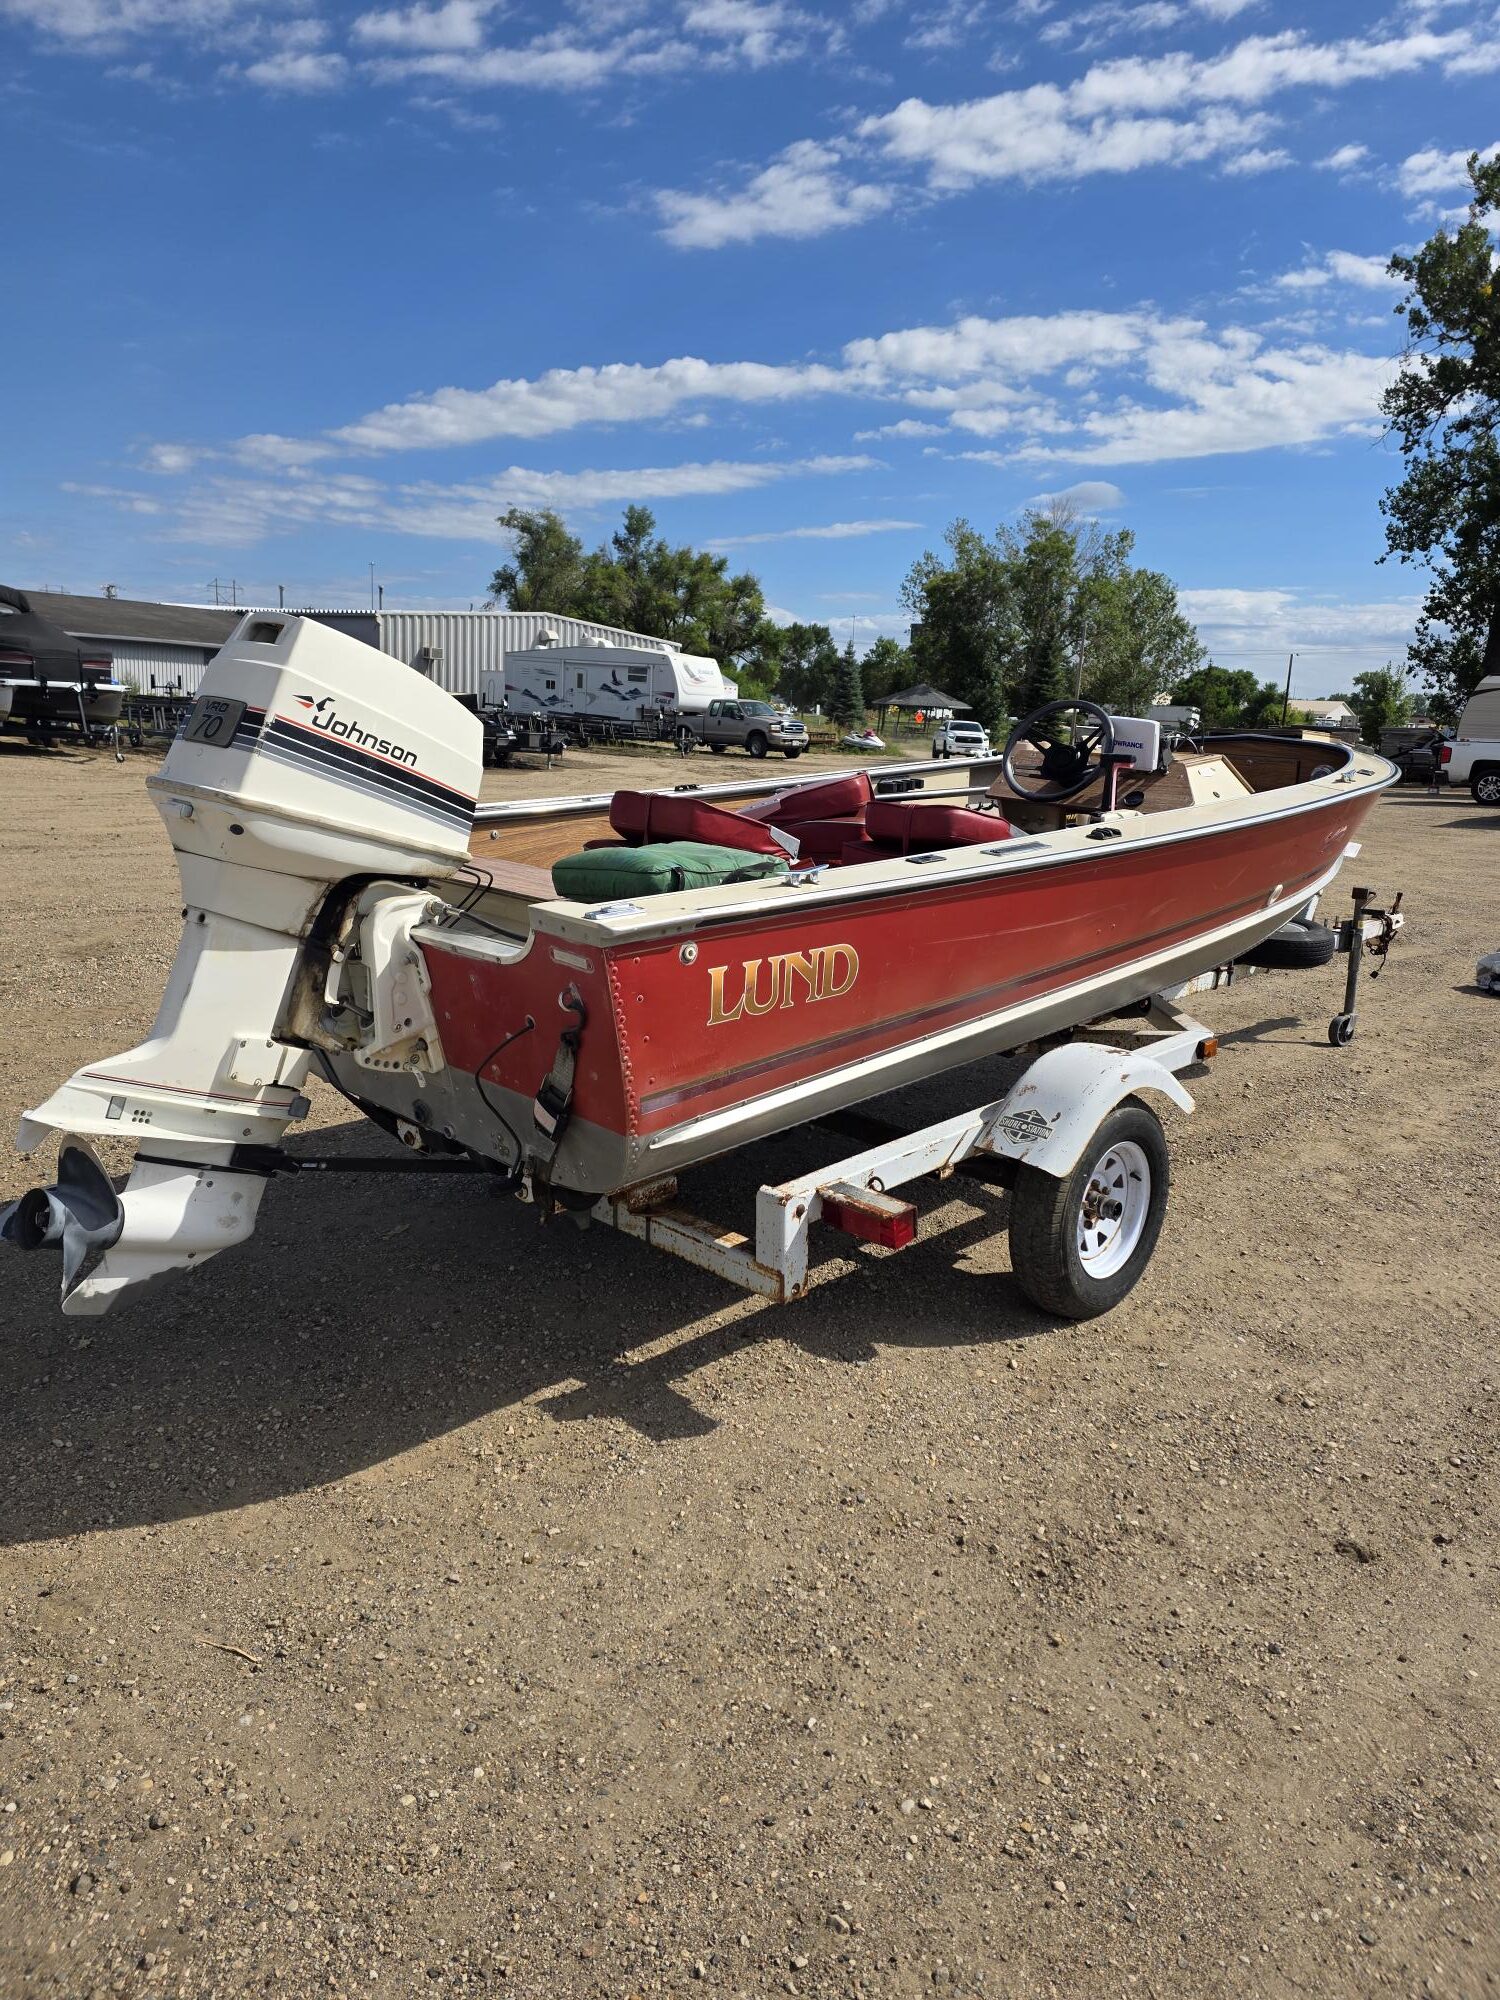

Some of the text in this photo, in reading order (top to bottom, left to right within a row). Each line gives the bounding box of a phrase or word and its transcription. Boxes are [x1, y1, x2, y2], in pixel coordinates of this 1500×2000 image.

[205, 700, 230, 713] VRO
[193, 713, 223, 738] 70
[311, 711, 418, 767] Johnson
[1113, 739, 1144, 749] OWRANCE
[706, 943, 860, 1026] LUND
[1001, 1117, 1052, 1138] SHORE STATION
